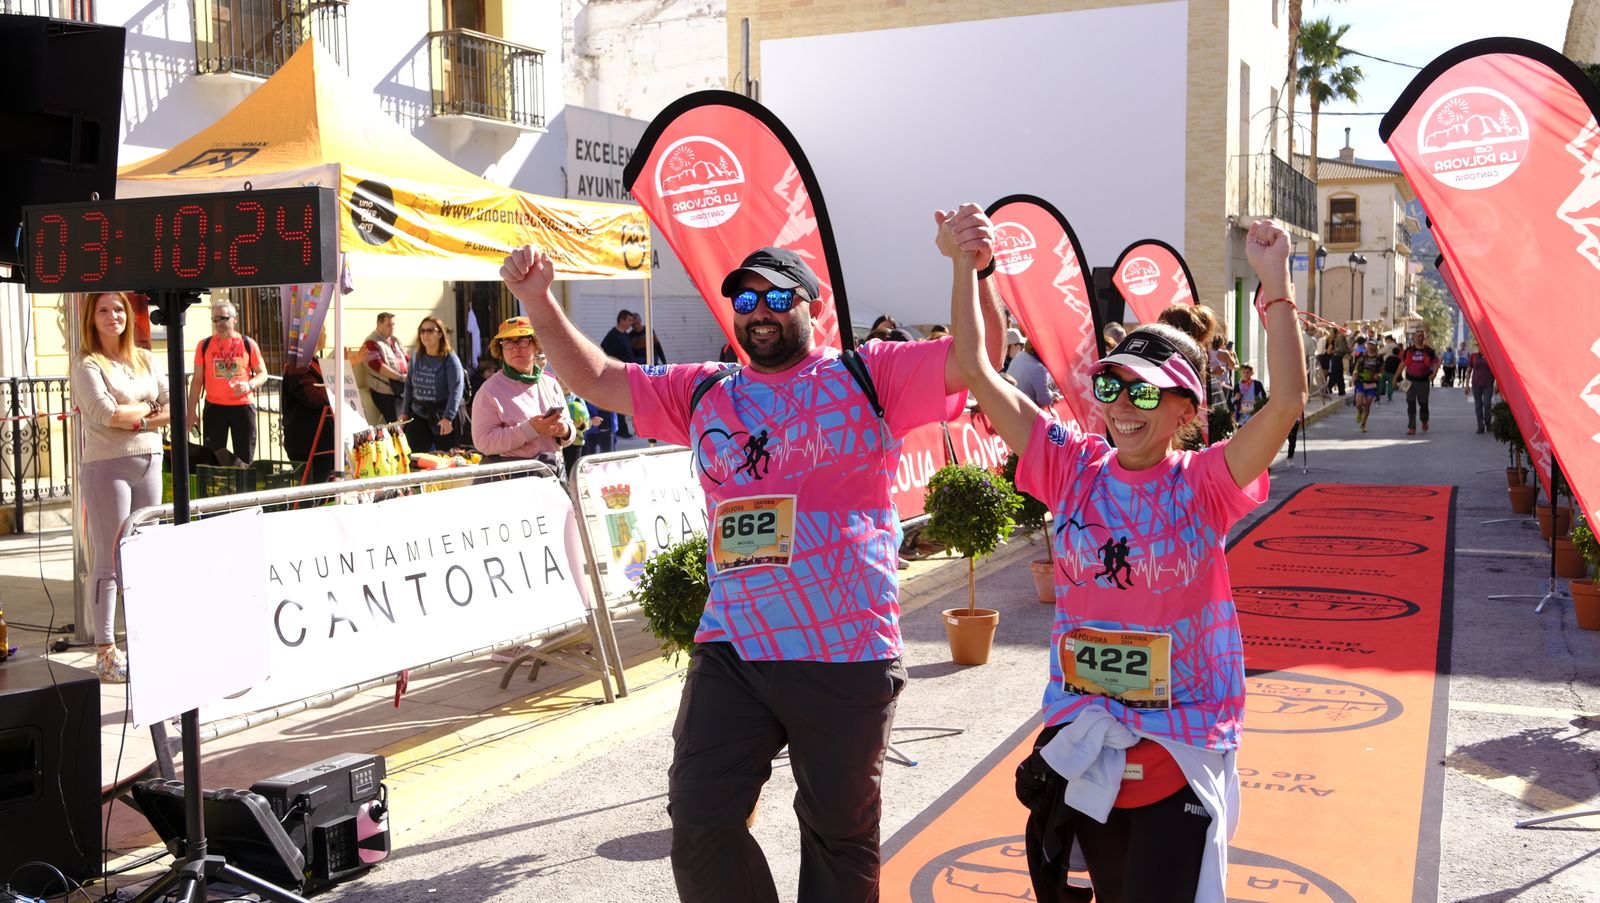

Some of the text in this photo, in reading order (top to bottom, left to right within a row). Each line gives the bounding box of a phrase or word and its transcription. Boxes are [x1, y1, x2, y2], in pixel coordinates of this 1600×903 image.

[578, 174, 635, 201] AYUNTA
[359, 200, 373, 208] uno
[36, 201, 313, 283] 03:10:24
[722, 512, 775, 539] 662
[268, 515, 548, 586] AYUNTAMIENTO DE
[273, 545, 564, 647] CANTORIA
[1241, 635, 1322, 645] Canto
[1076, 646, 1148, 676] 422
[1325, 689, 1366, 697] LA
[1271, 771, 1317, 782] de
[1184, 802, 1209, 817] PUM
[1247, 876, 1309, 895] LA
